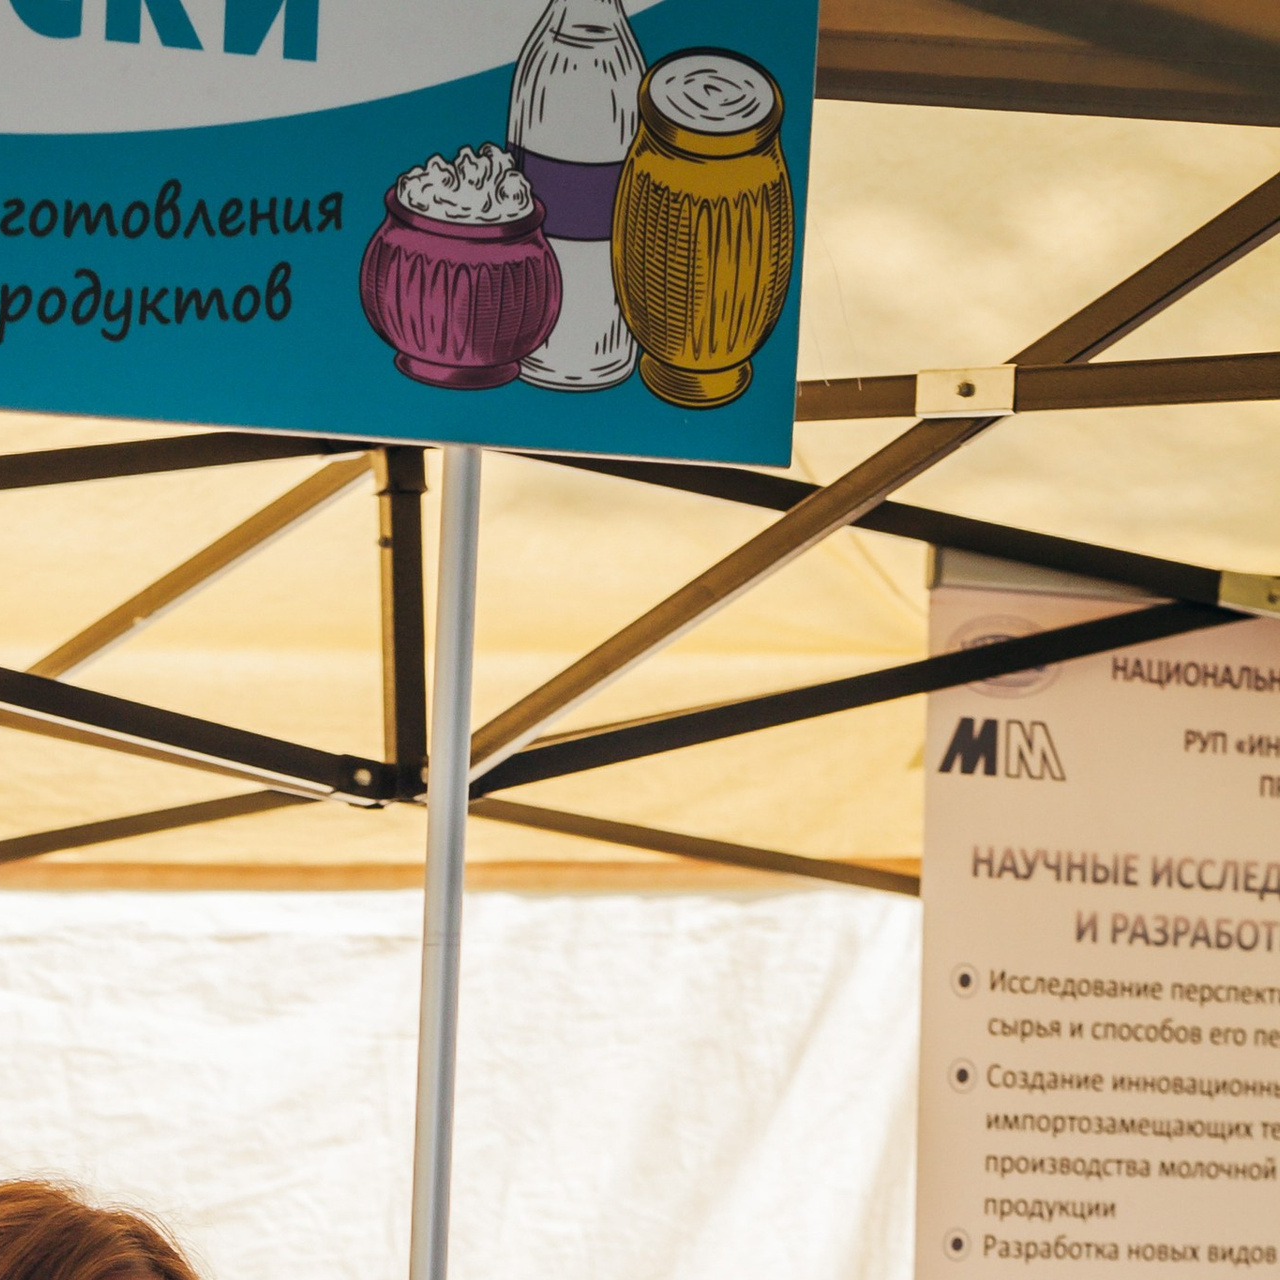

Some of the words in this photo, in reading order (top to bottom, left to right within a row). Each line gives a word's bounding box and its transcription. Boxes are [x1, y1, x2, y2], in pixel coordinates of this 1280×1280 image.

[1183, 728, 1228, 755] РУП
[971, 844, 1140, 888] НАУЧНЫЕ
[1075, 910, 1099, 944] И
[988, 969, 1164, 1001] Исследование
[987, 1016, 1062, 1044] сырья
[1069, 1021, 1084, 1039] и
[1091, 1017, 1203, 1046] способов
[1208, 1025, 1248, 1047] его
[986, 1063, 1105, 1095] Создание
[985, 1112, 1253, 1143] импортозамещающих
[984, 1154, 1152, 1181] производства
[1157, 1156, 1278, 1182] молочной
[982, 1197, 1117, 1224] продукции
[982, 1233, 1120, 1264] Разработка
[1126, 1243, 1201, 1262] новых
[1207, 1243, 1278, 1267] видов
